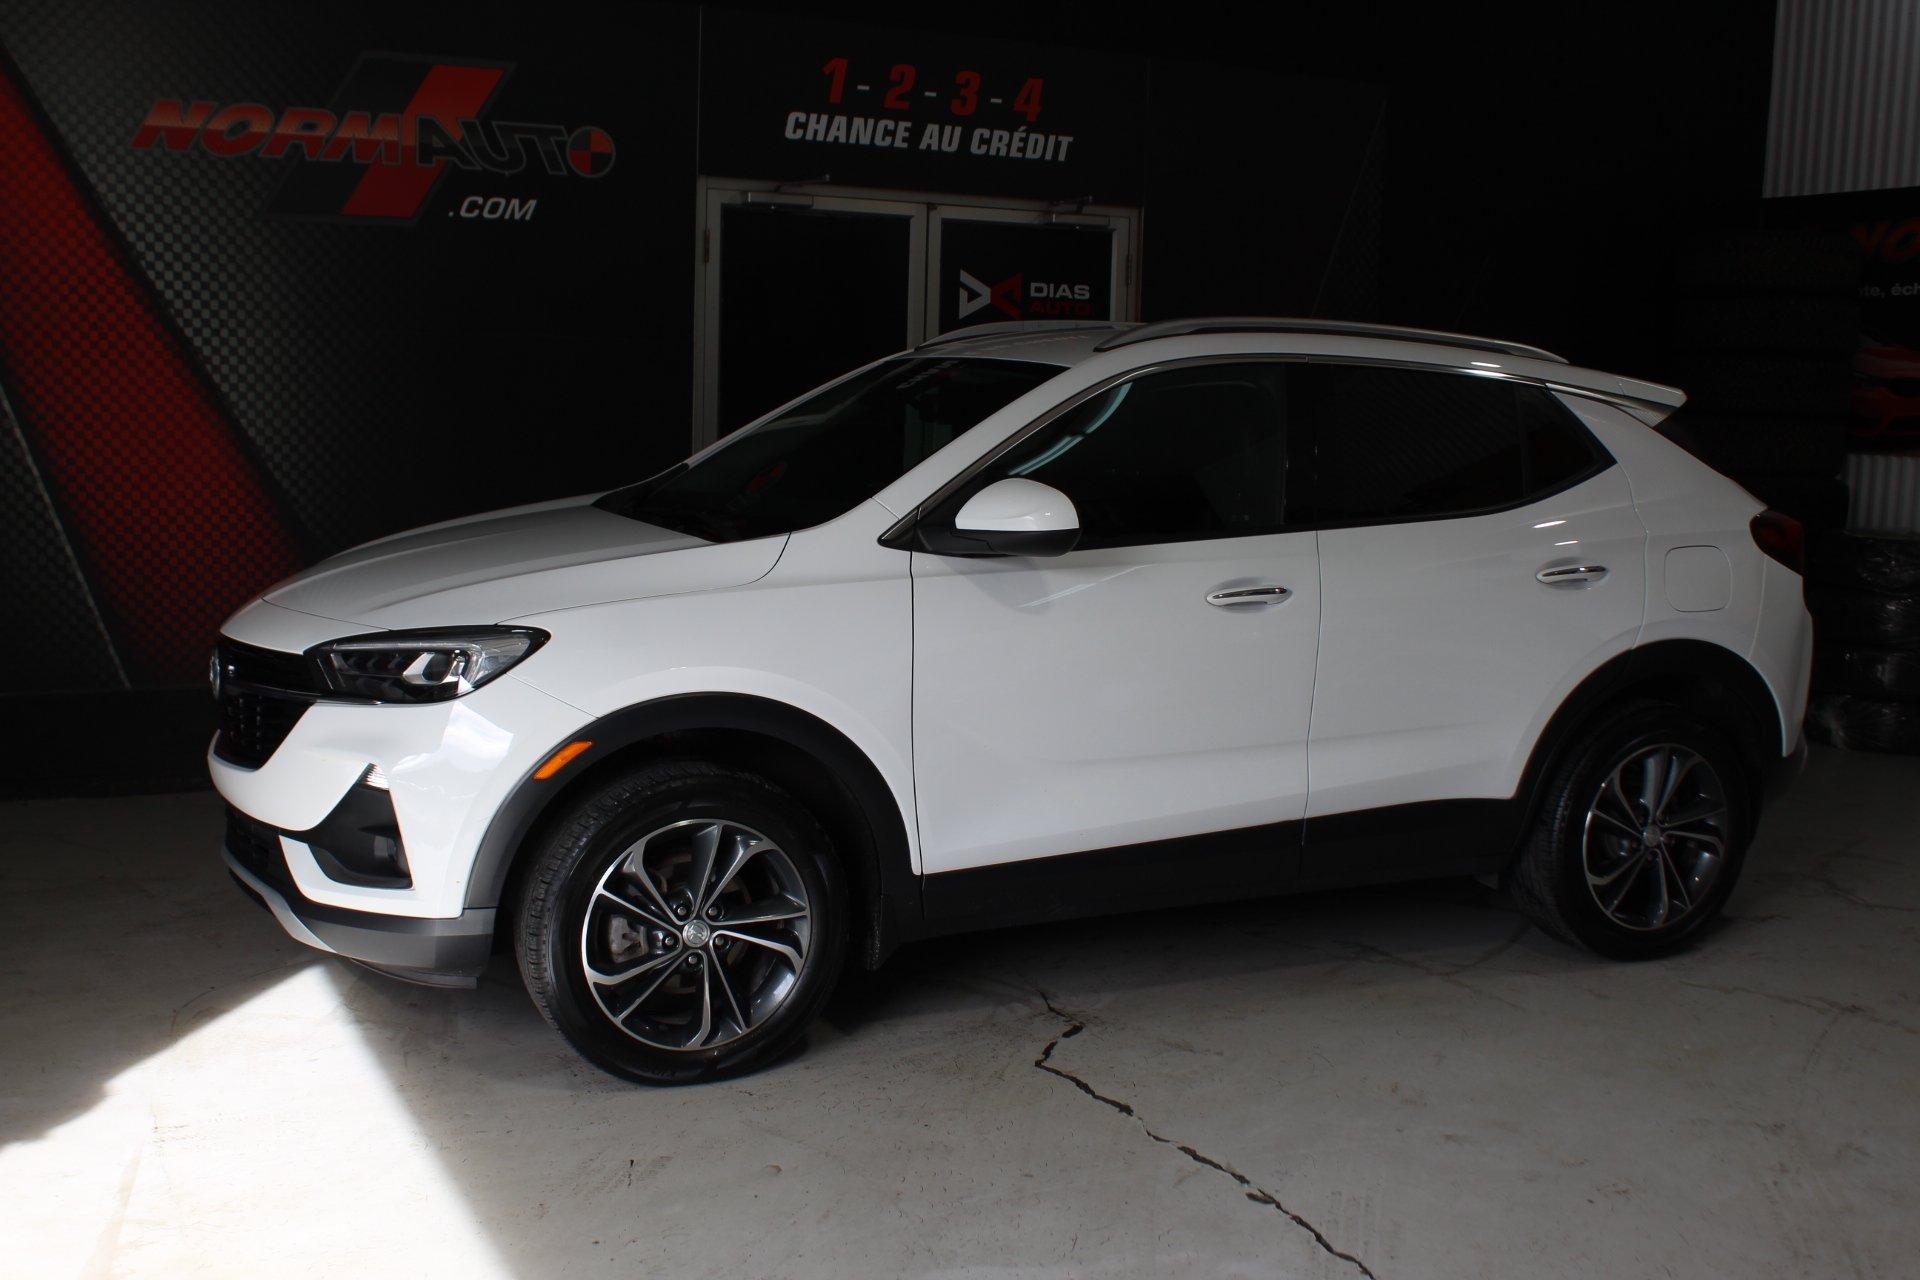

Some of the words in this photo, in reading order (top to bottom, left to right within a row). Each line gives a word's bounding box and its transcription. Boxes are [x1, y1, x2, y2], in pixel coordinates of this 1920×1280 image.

[784, 111, 912, 149] CHANCE
[918, 123, 962, 153] AU
[969, 125, 1074, 162] CRÉDIT
[1030, 282, 1091, 300] DIAS
